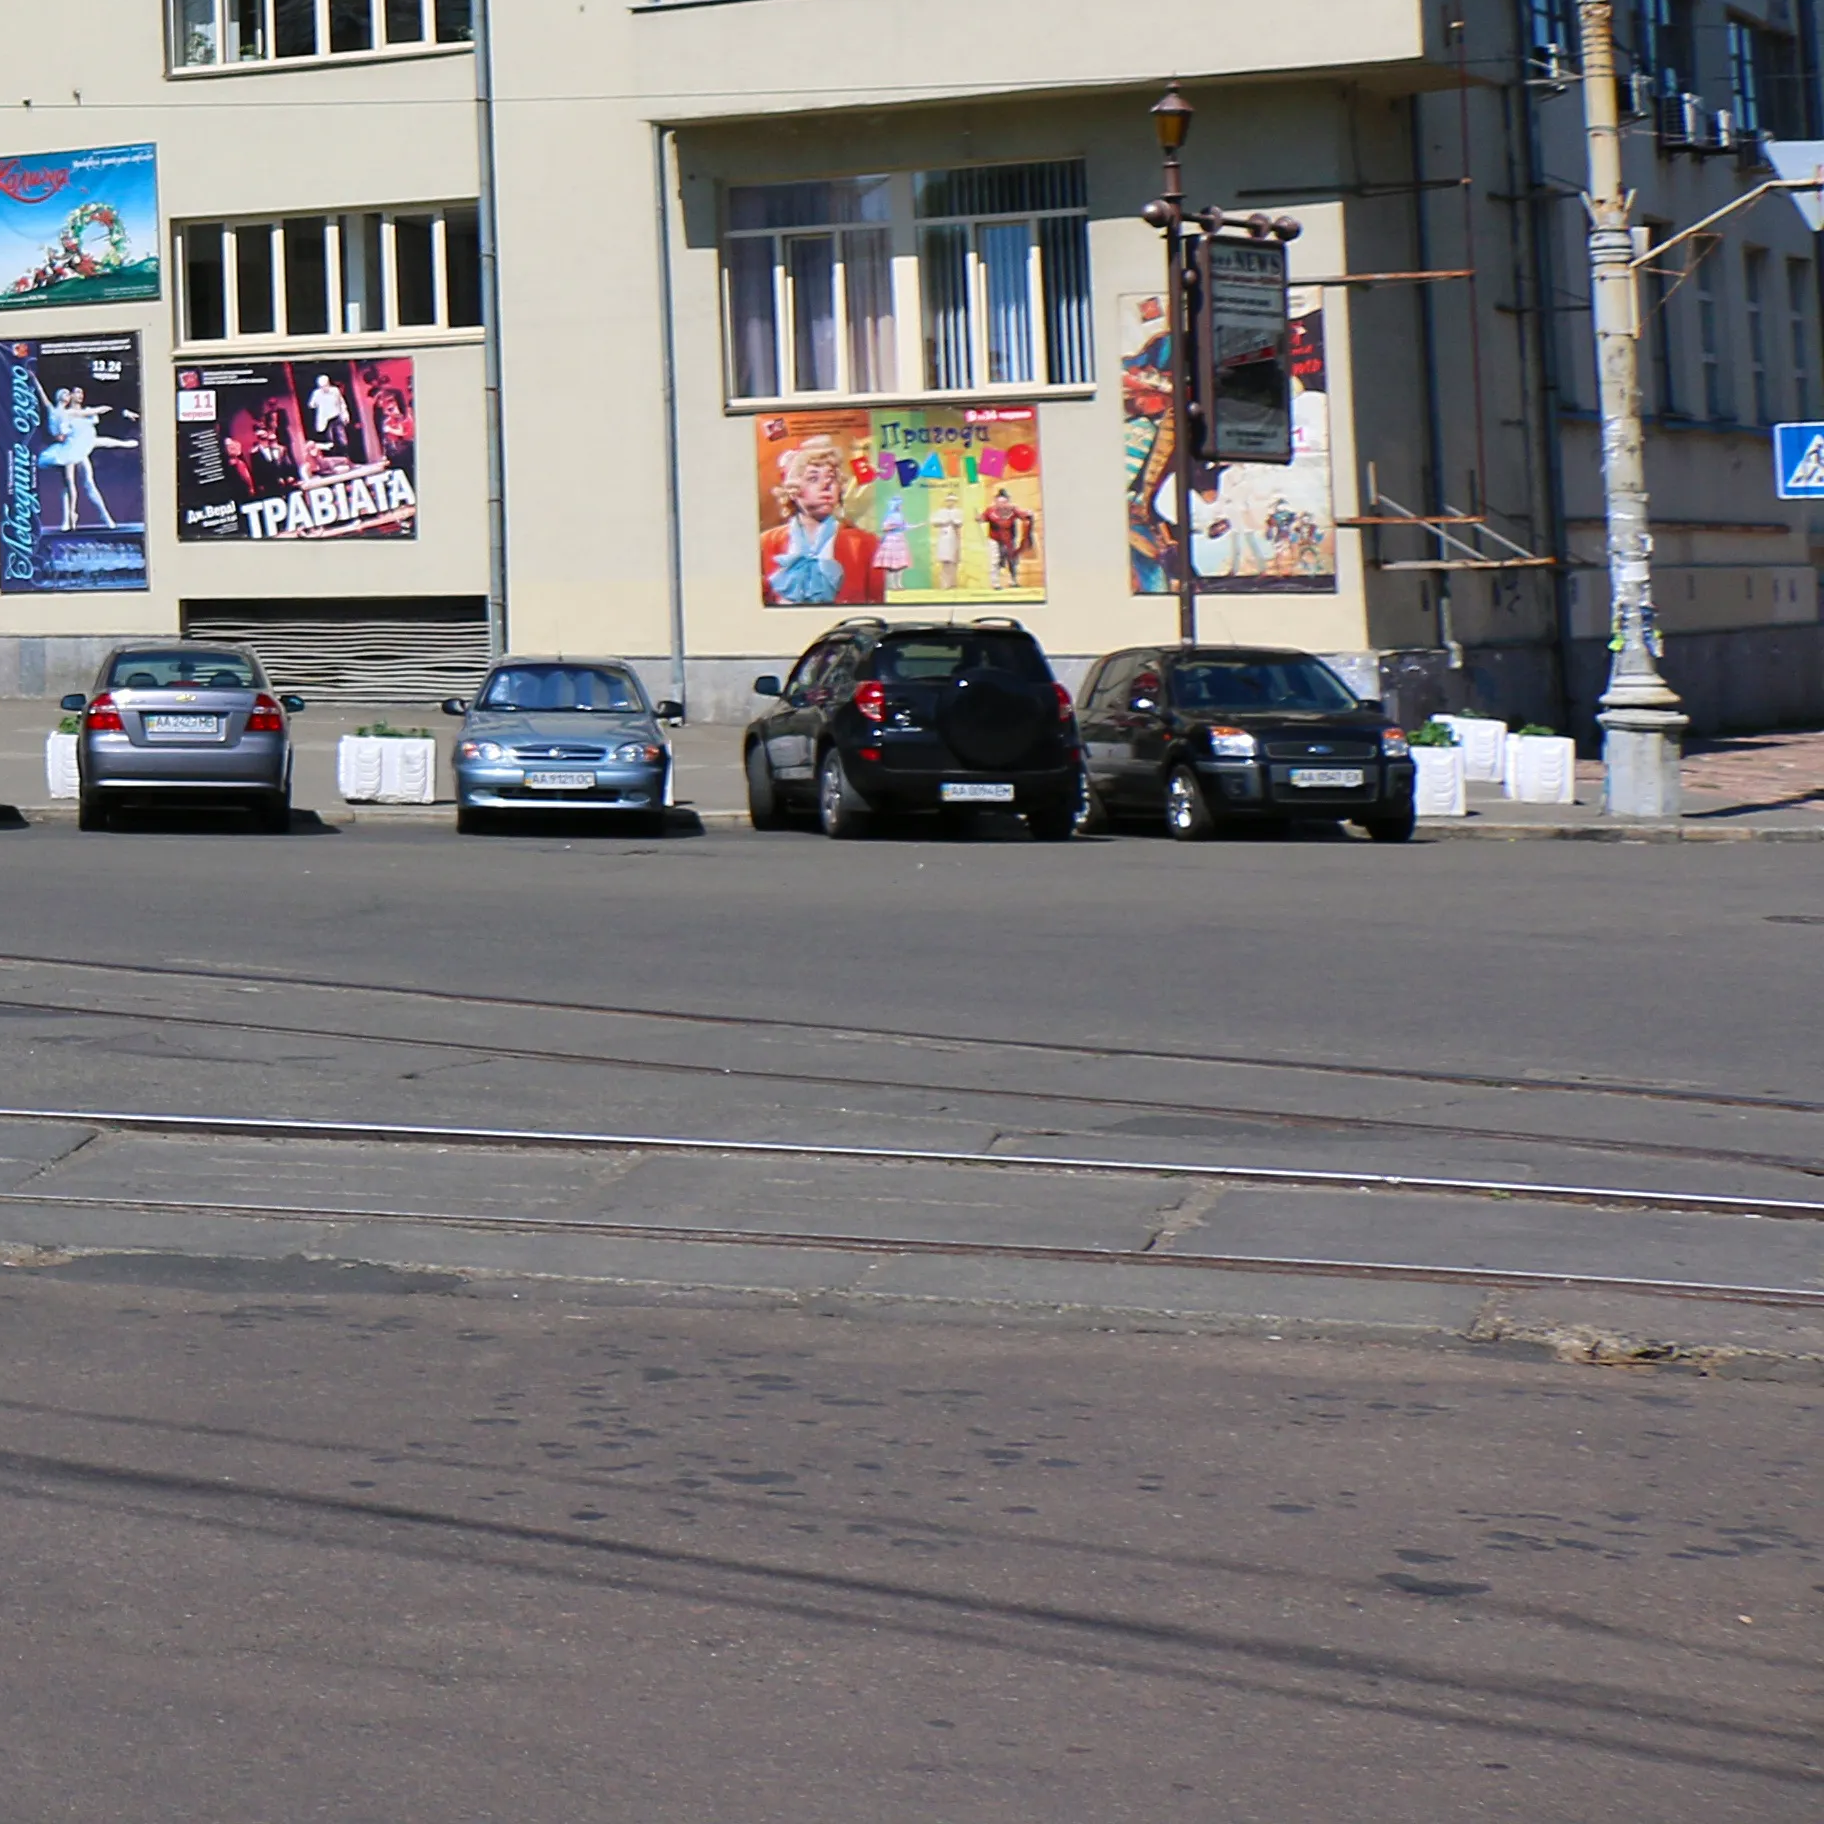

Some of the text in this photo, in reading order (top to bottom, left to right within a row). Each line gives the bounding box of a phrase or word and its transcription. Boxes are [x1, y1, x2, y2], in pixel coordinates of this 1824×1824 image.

[194, 393, 213, 408] 11
[881, 420, 991, 450] Пригоди
[241, 468, 417, 539] ТРАВІАТА
